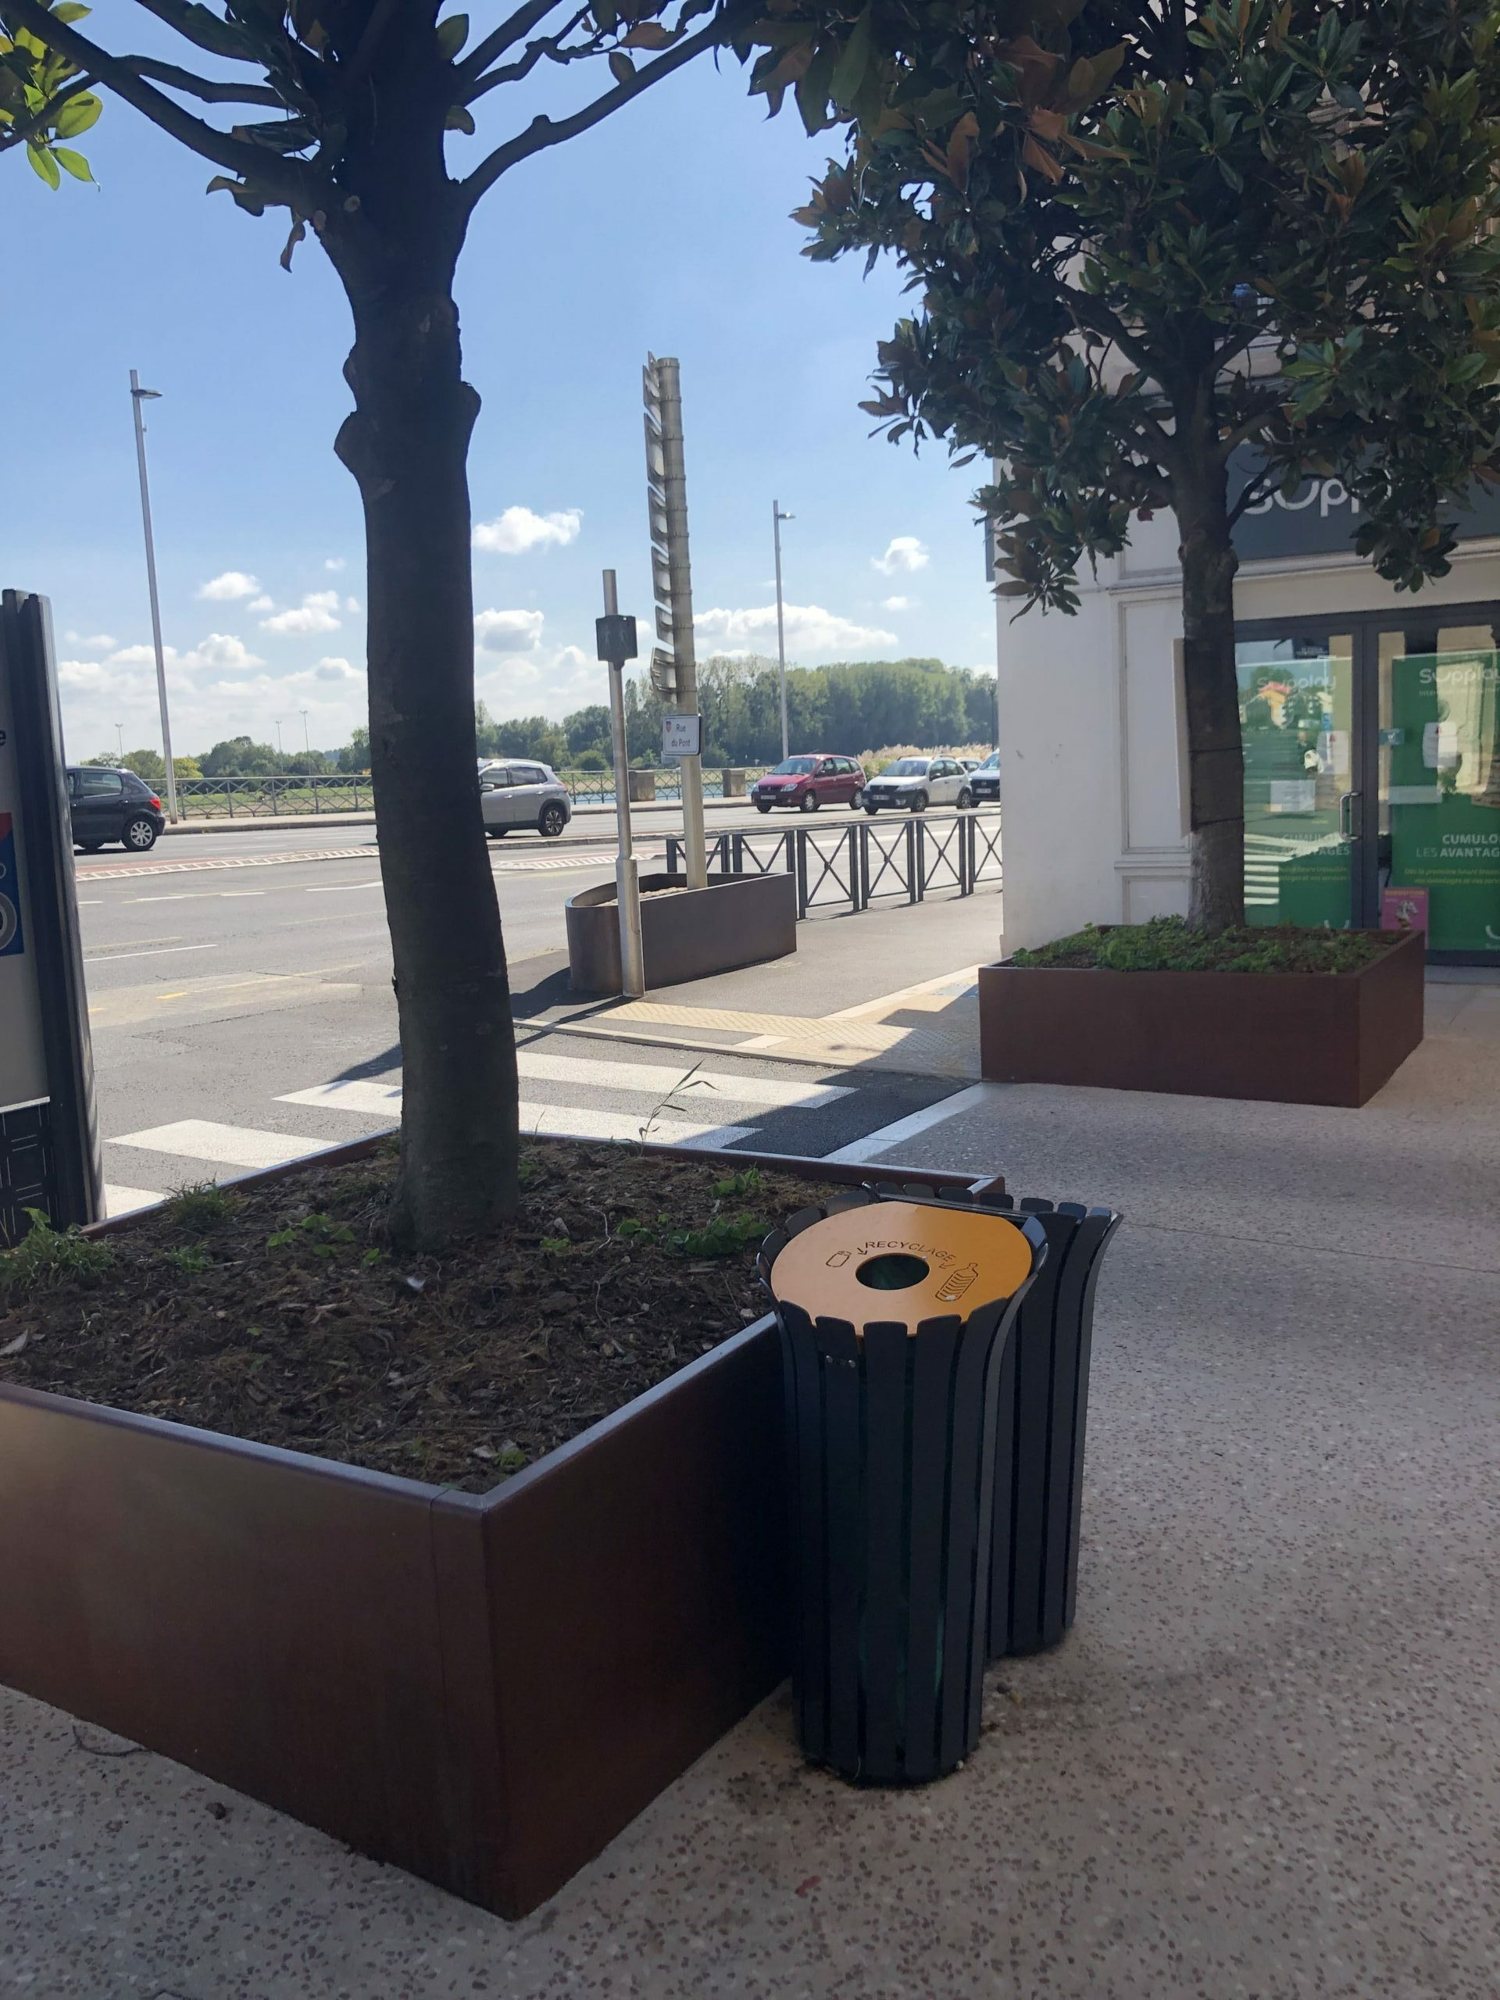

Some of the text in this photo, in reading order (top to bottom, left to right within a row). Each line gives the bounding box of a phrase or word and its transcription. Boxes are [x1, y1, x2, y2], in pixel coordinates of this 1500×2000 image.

[676, 723, 686, 732] Rue
[679, 738, 690, 747] Pont
[1441, 833, 1500, 845] CUMULO
[1416, 847, 1438, 858] LES
[865, 1240, 956, 1262] RECYCLAGE
